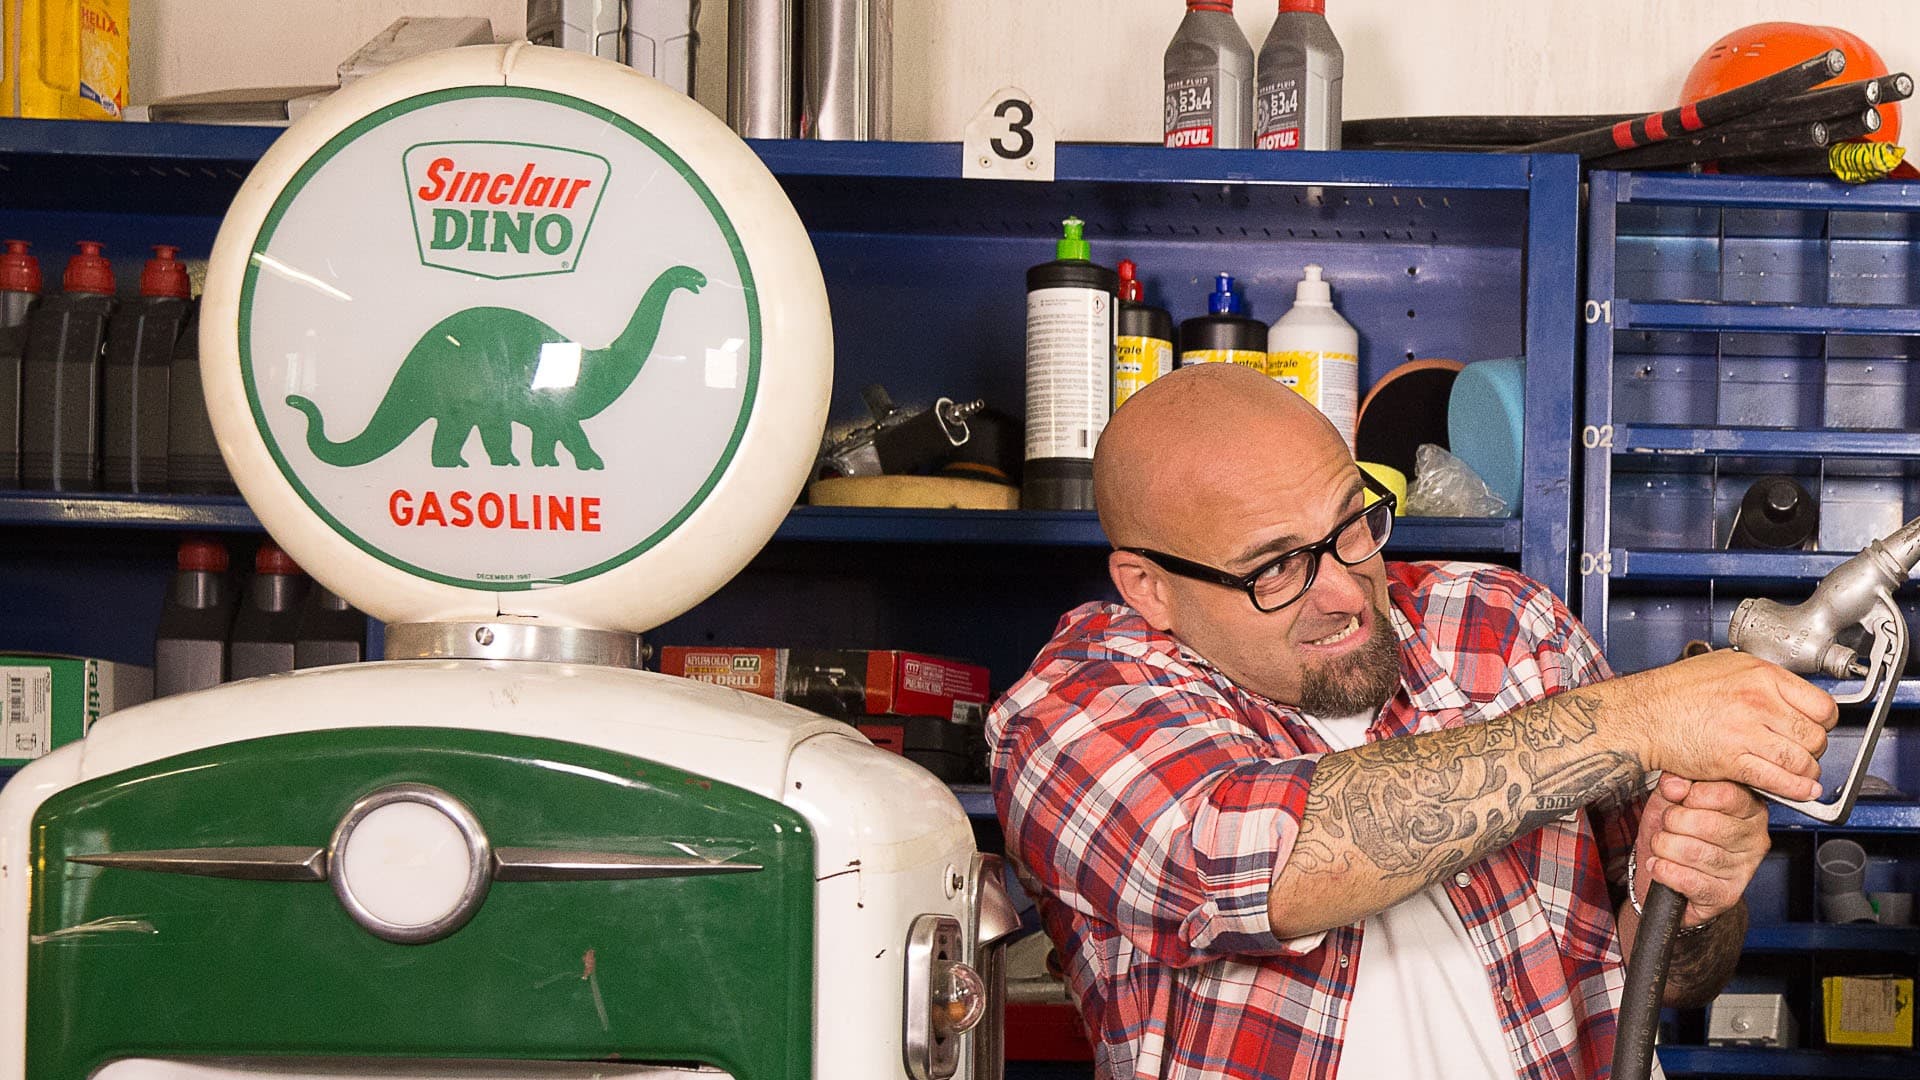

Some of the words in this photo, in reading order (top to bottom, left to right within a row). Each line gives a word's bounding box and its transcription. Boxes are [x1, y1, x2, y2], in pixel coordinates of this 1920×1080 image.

[1180, 90, 1188, 113] DOT
[990, 99, 1034, 159] 3
[1166, 128, 1210, 148] MOTUL
[1257, 131, 1297, 149] MOTUL
[418, 157, 592, 209] Sinclair
[430, 208, 574, 256] DINO
[1585, 300, 1611, 324] 01
[1582, 425, 1614, 449] 02
[389, 489, 601, 532] GASOLINE
[1580, 552, 1612, 576] 03
[716, 674, 757, 687] DRILL
